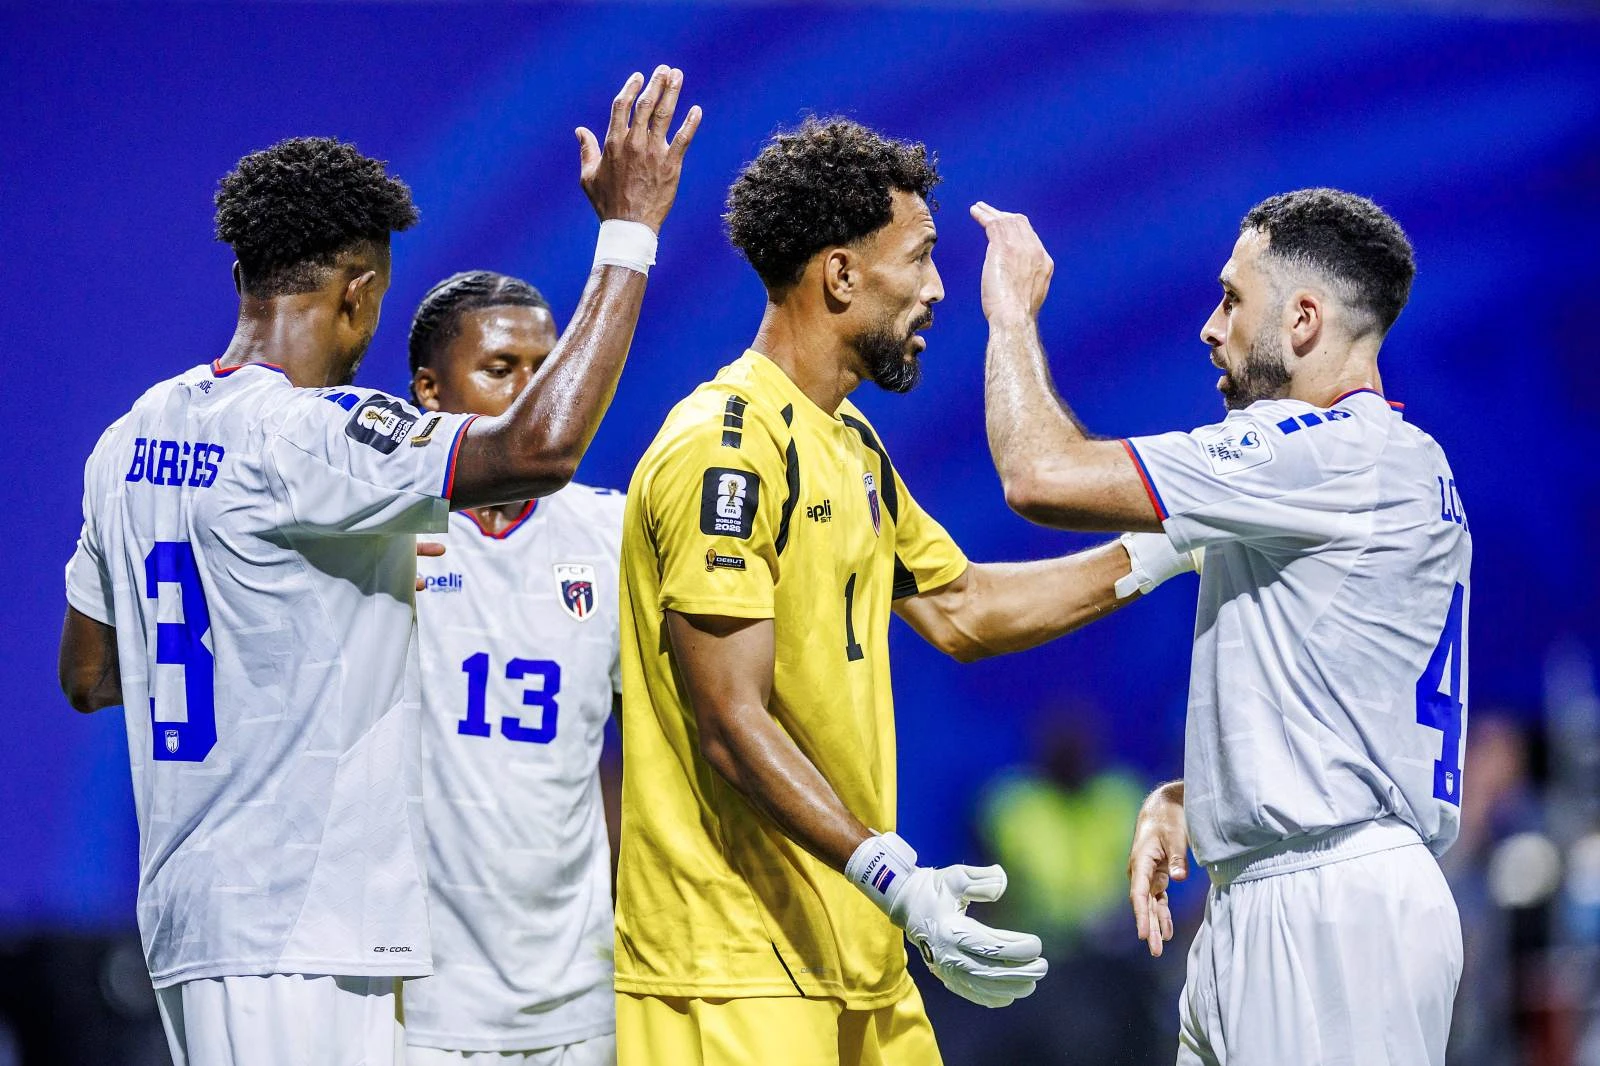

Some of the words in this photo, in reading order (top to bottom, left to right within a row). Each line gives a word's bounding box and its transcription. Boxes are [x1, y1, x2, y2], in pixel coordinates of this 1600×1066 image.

[714, 523, 741, 533] 2026
[716, 557, 743, 565] DEBUT
[418, 572, 462, 589] pelli
[844, 572, 864, 662] 1
[144, 541, 217, 762] 3
[1416, 581, 1464, 807] 4
[457, 652, 561, 744] 13
